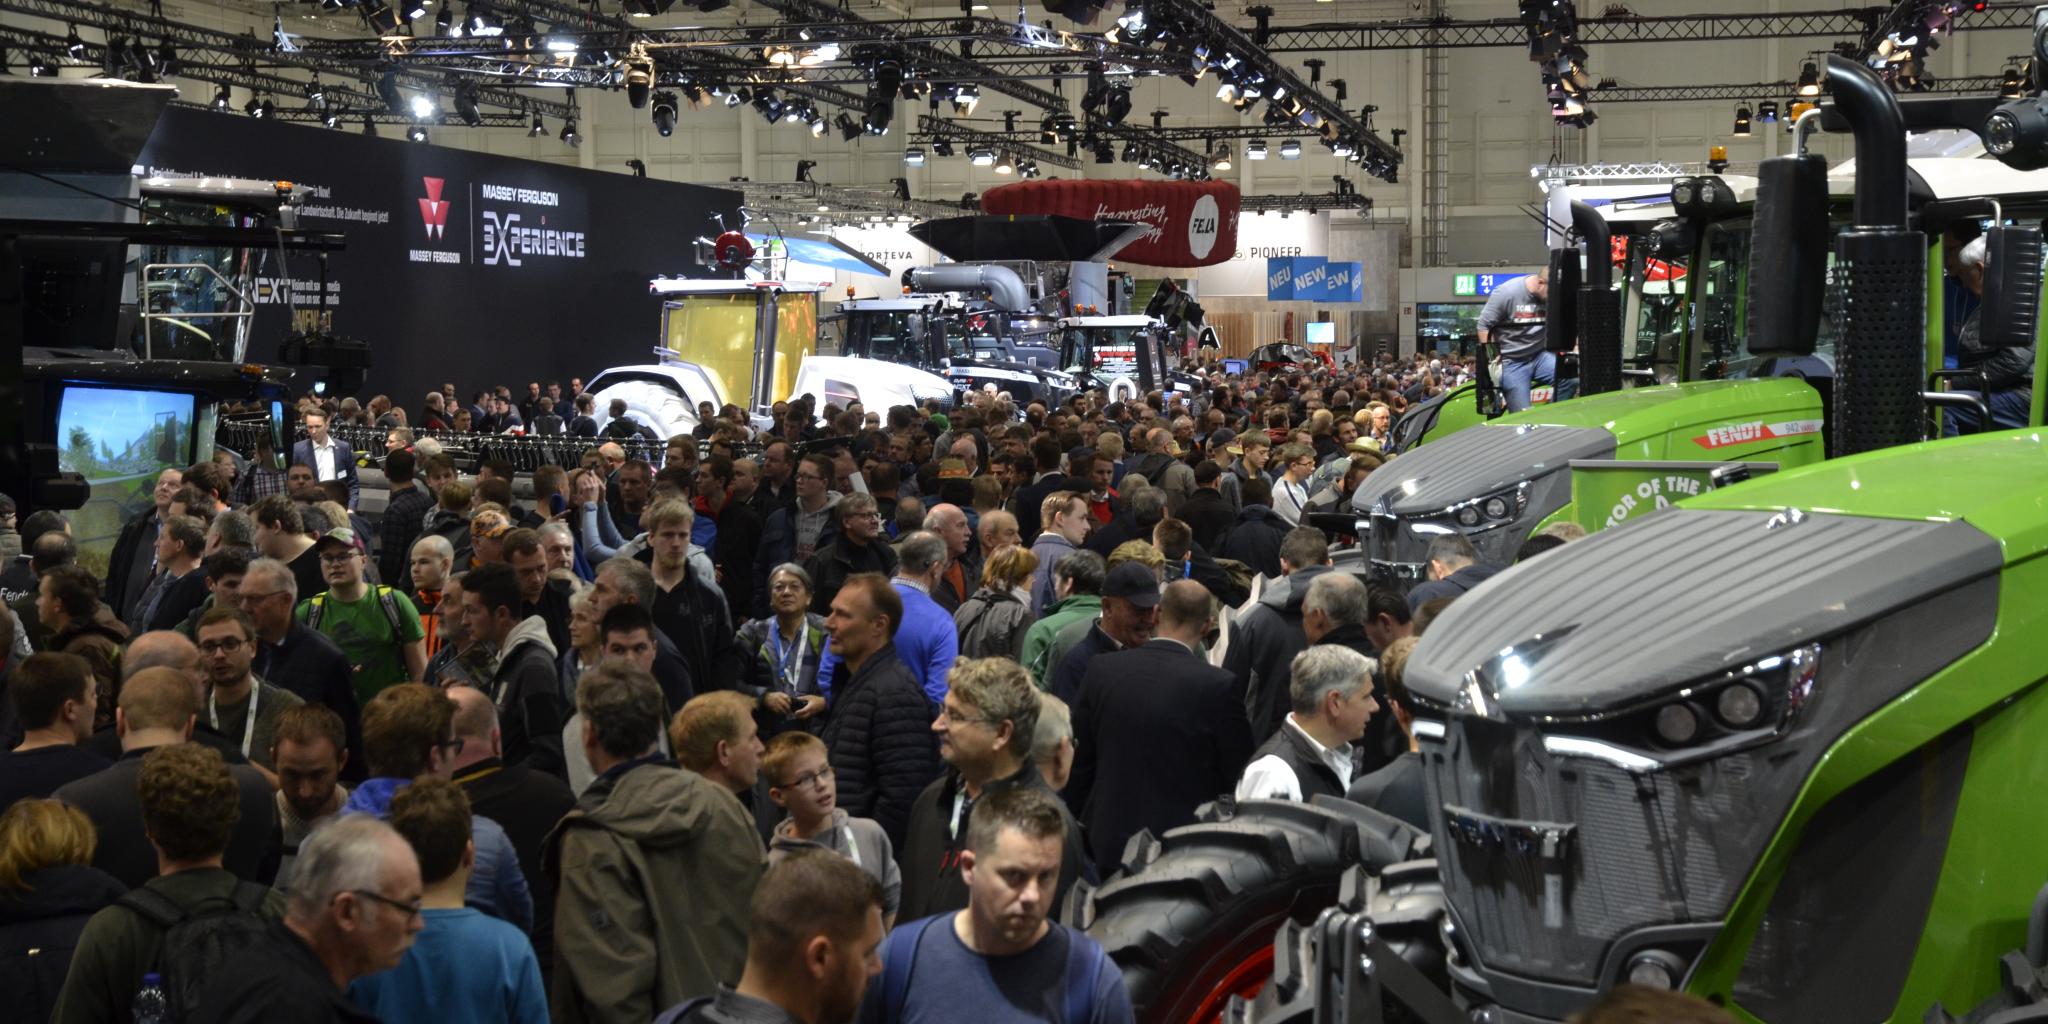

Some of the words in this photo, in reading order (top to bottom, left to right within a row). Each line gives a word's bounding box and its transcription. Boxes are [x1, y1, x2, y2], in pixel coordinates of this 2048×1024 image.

[482, 184, 517, 201] MASSEY
[517, 190, 559, 206] FERGUSON
[345, 208, 361, 220] Zukunft
[362, 209, 377, 224] beginnt
[1094, 203, 1167, 223] Harvesting
[409, 250, 432, 262] MASSEY
[433, 251, 460, 264] FERGUSON
[863, 251, 912, 260] ORTEVA
[1250, 246, 1302, 258] PIONEER
[292, 278, 305, 290] Vision
[1269, 266, 1291, 291] NEU
[1294, 265, 1326, 291] NEW
[1327, 270, 1349, 290] EW
[1481, 275, 1493, 286] 21
[292, 292, 305, 304] Vision
[1707, 421, 1763, 446] FENDT
[1785, 423, 1799, 433] 942
[1604, 494, 1637, 531] TOR
[1637, 478, 1660, 498] OF
[1665, 476, 1700, 496] THE
